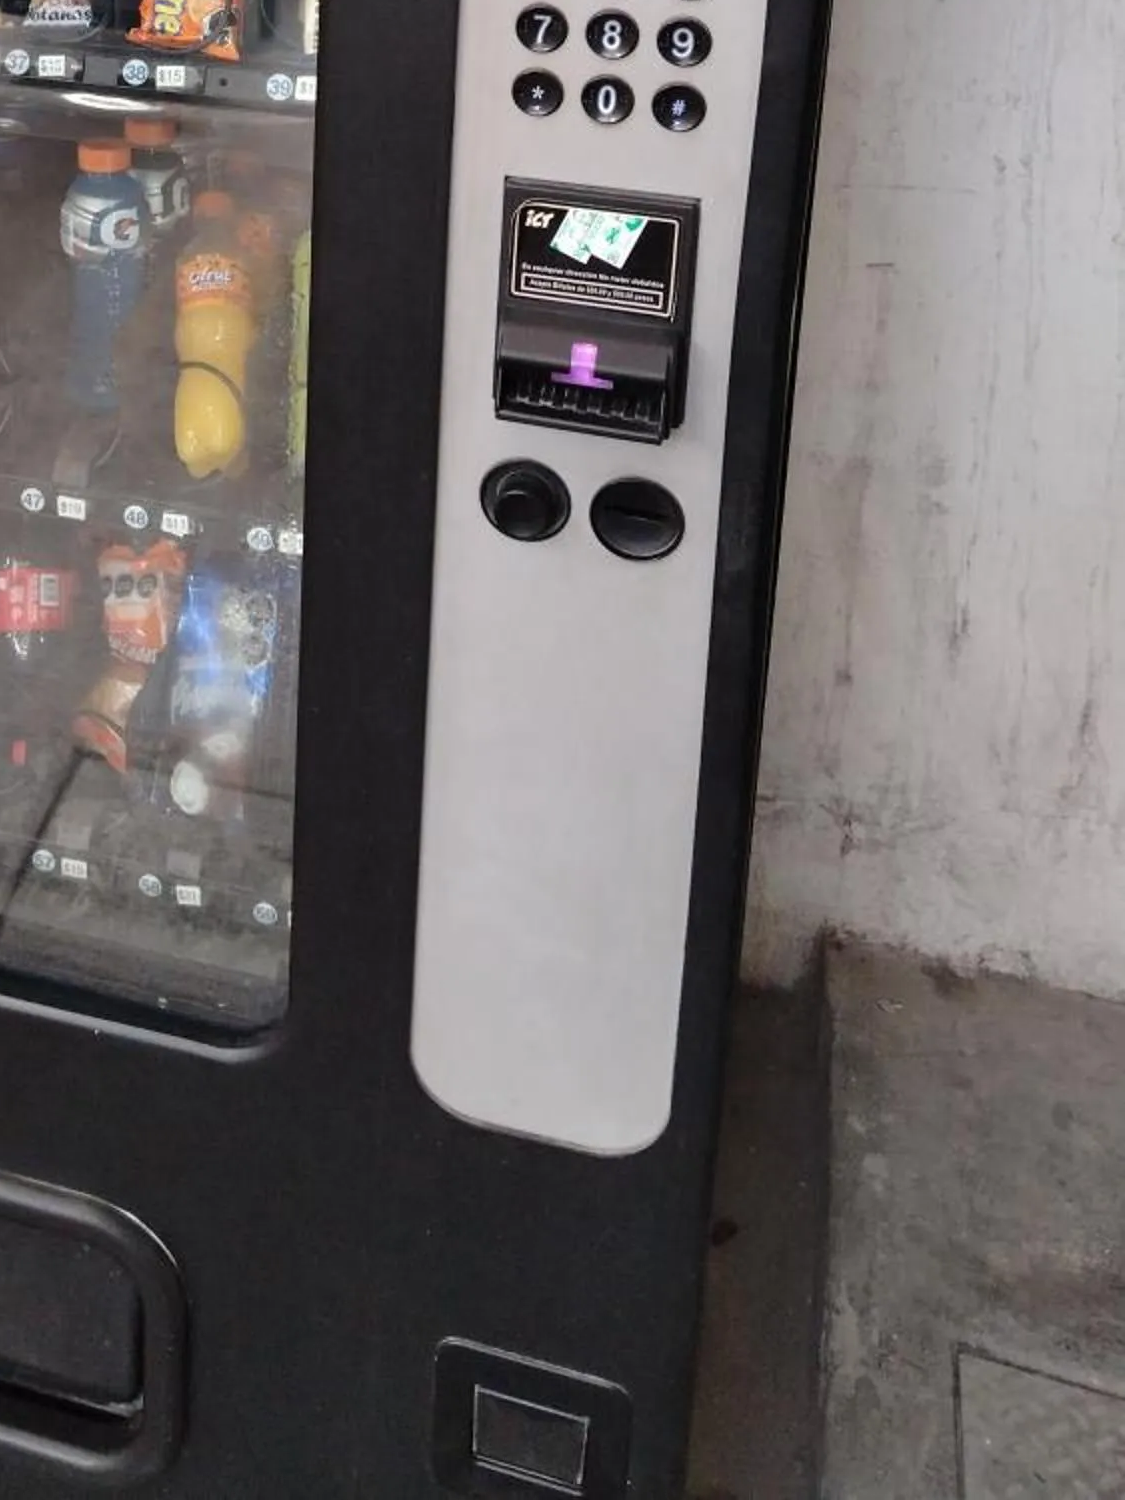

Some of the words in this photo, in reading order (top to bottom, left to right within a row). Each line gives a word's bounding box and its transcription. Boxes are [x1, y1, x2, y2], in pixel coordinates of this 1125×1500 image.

[533, 15, 552, 43] 7
[603, 20, 621, 49] 8
[672, 28, 694, 57] 9
[9, 52, 27, 68] 37
[125, 63, 146, 80] 38
[158, 70, 182, 85] $15
[269, 78, 291, 96] 39
[598, 86, 616, 114] 0
[100, 209, 140, 249] G
[25, 492, 43, 507] 47
[128, 509, 147, 525] 48
